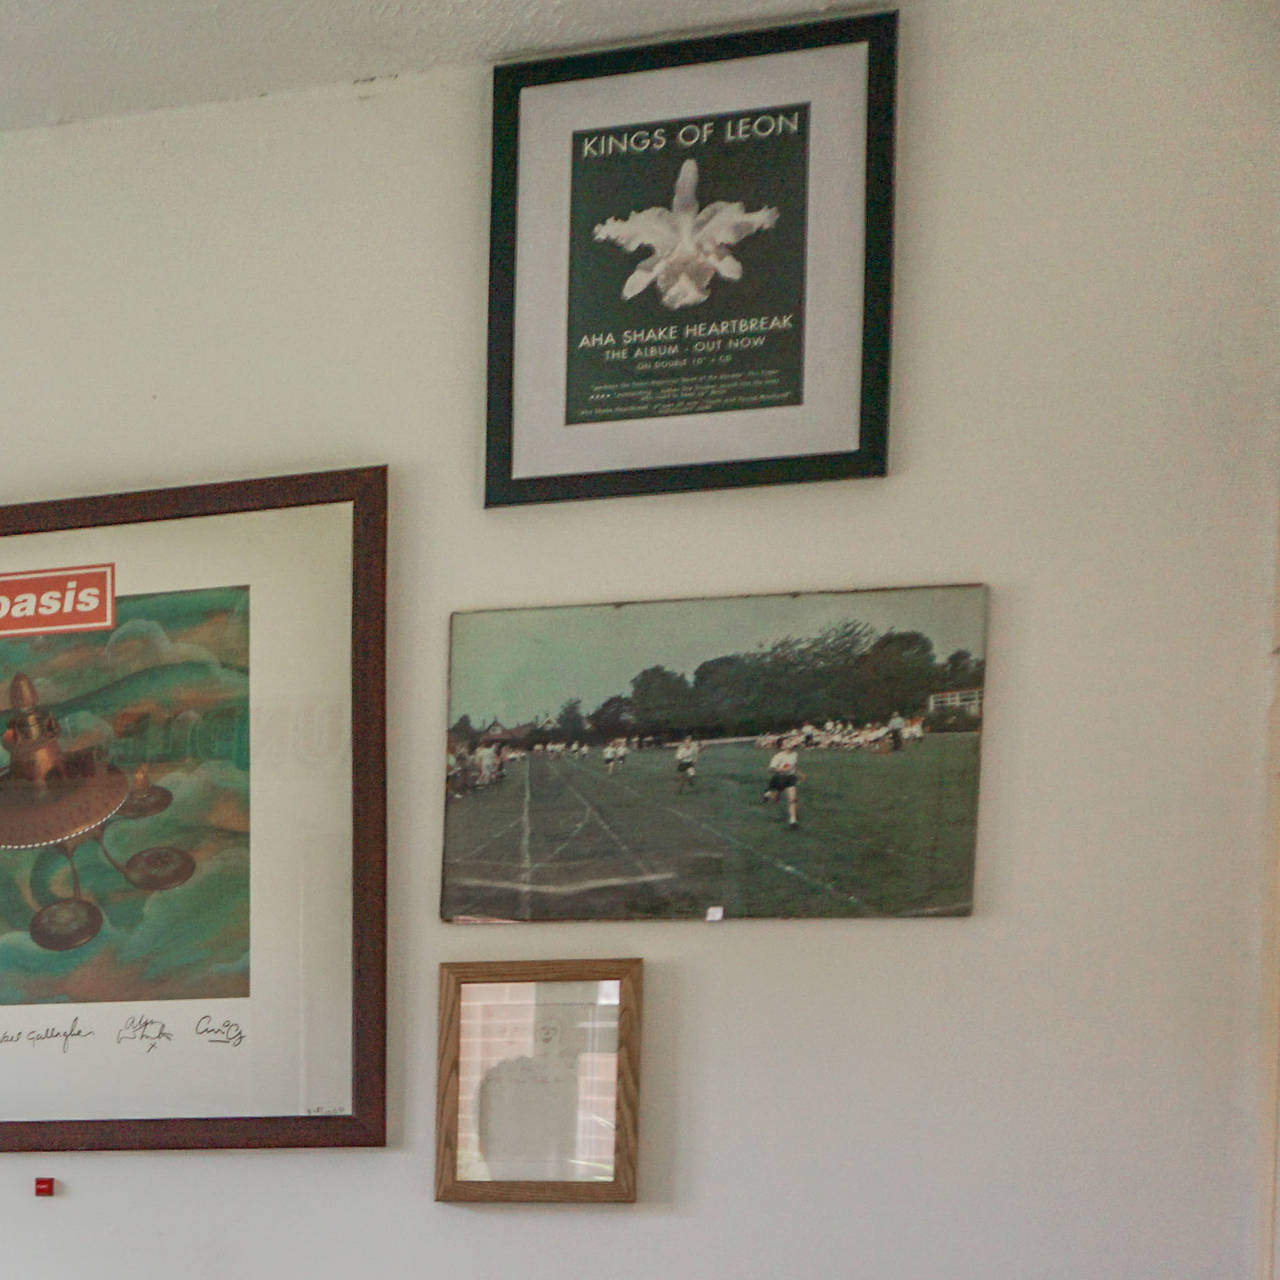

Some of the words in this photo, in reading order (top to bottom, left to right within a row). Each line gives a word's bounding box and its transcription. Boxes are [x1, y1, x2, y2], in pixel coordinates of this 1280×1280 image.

[582, 128, 666, 159] KINGS
[678, 121, 714, 147] OF
[725, 112, 799, 142] LEON
[578, 332, 616, 349] AHA
[623, 325, 678, 345] SHAKE
[684, 313, 793, 338] HEARTBREAK
[604, 349, 628, 361] THE
[634, 344, 679, 359] ALBUM
[694, 340, 722, 353] OUT
[728, 336, 767, 350] NOW
